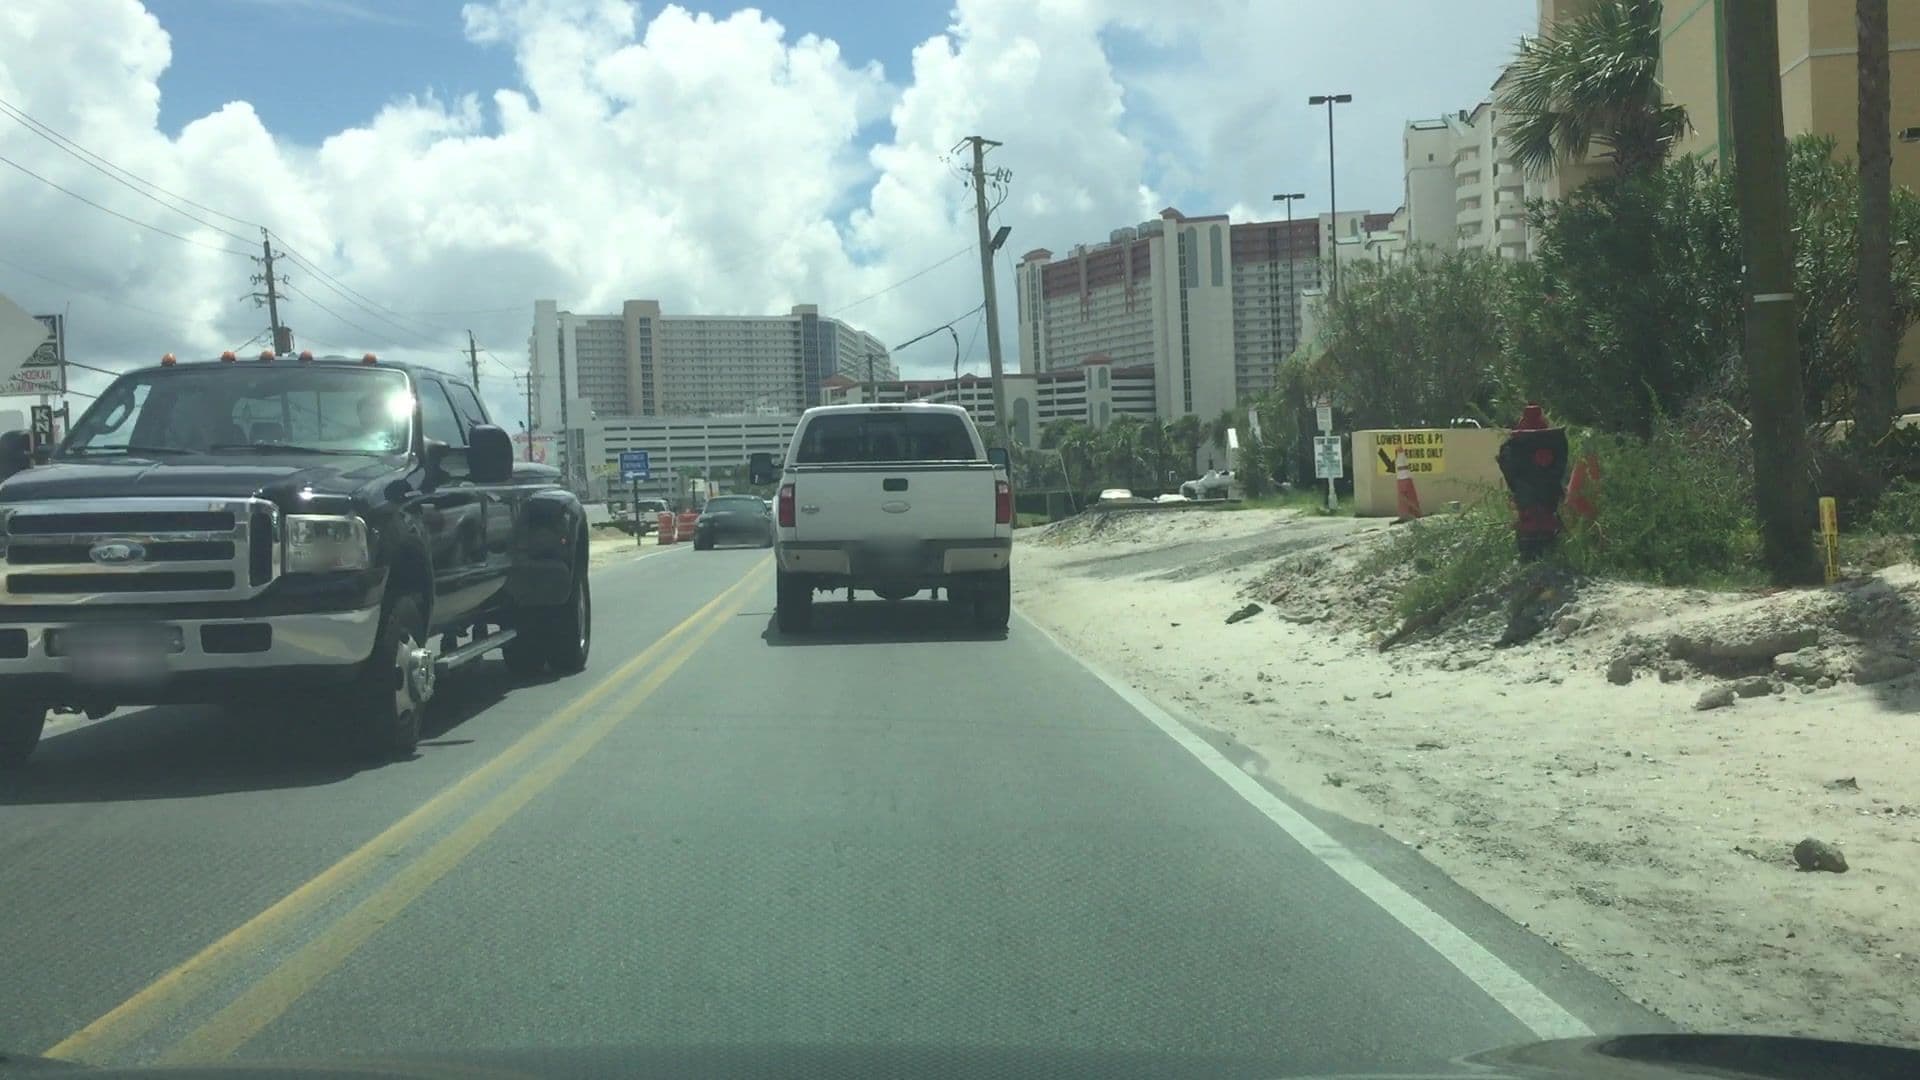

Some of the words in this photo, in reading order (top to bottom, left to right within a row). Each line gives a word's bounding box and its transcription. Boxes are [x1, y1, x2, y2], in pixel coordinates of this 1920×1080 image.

[1376, 434, 1401, 445] LOWER
[1404, 434, 1425, 444] LEVEL
[1395, 448, 1425, 459] PRKING
[1427, 448, 1443, 458] ONLY
